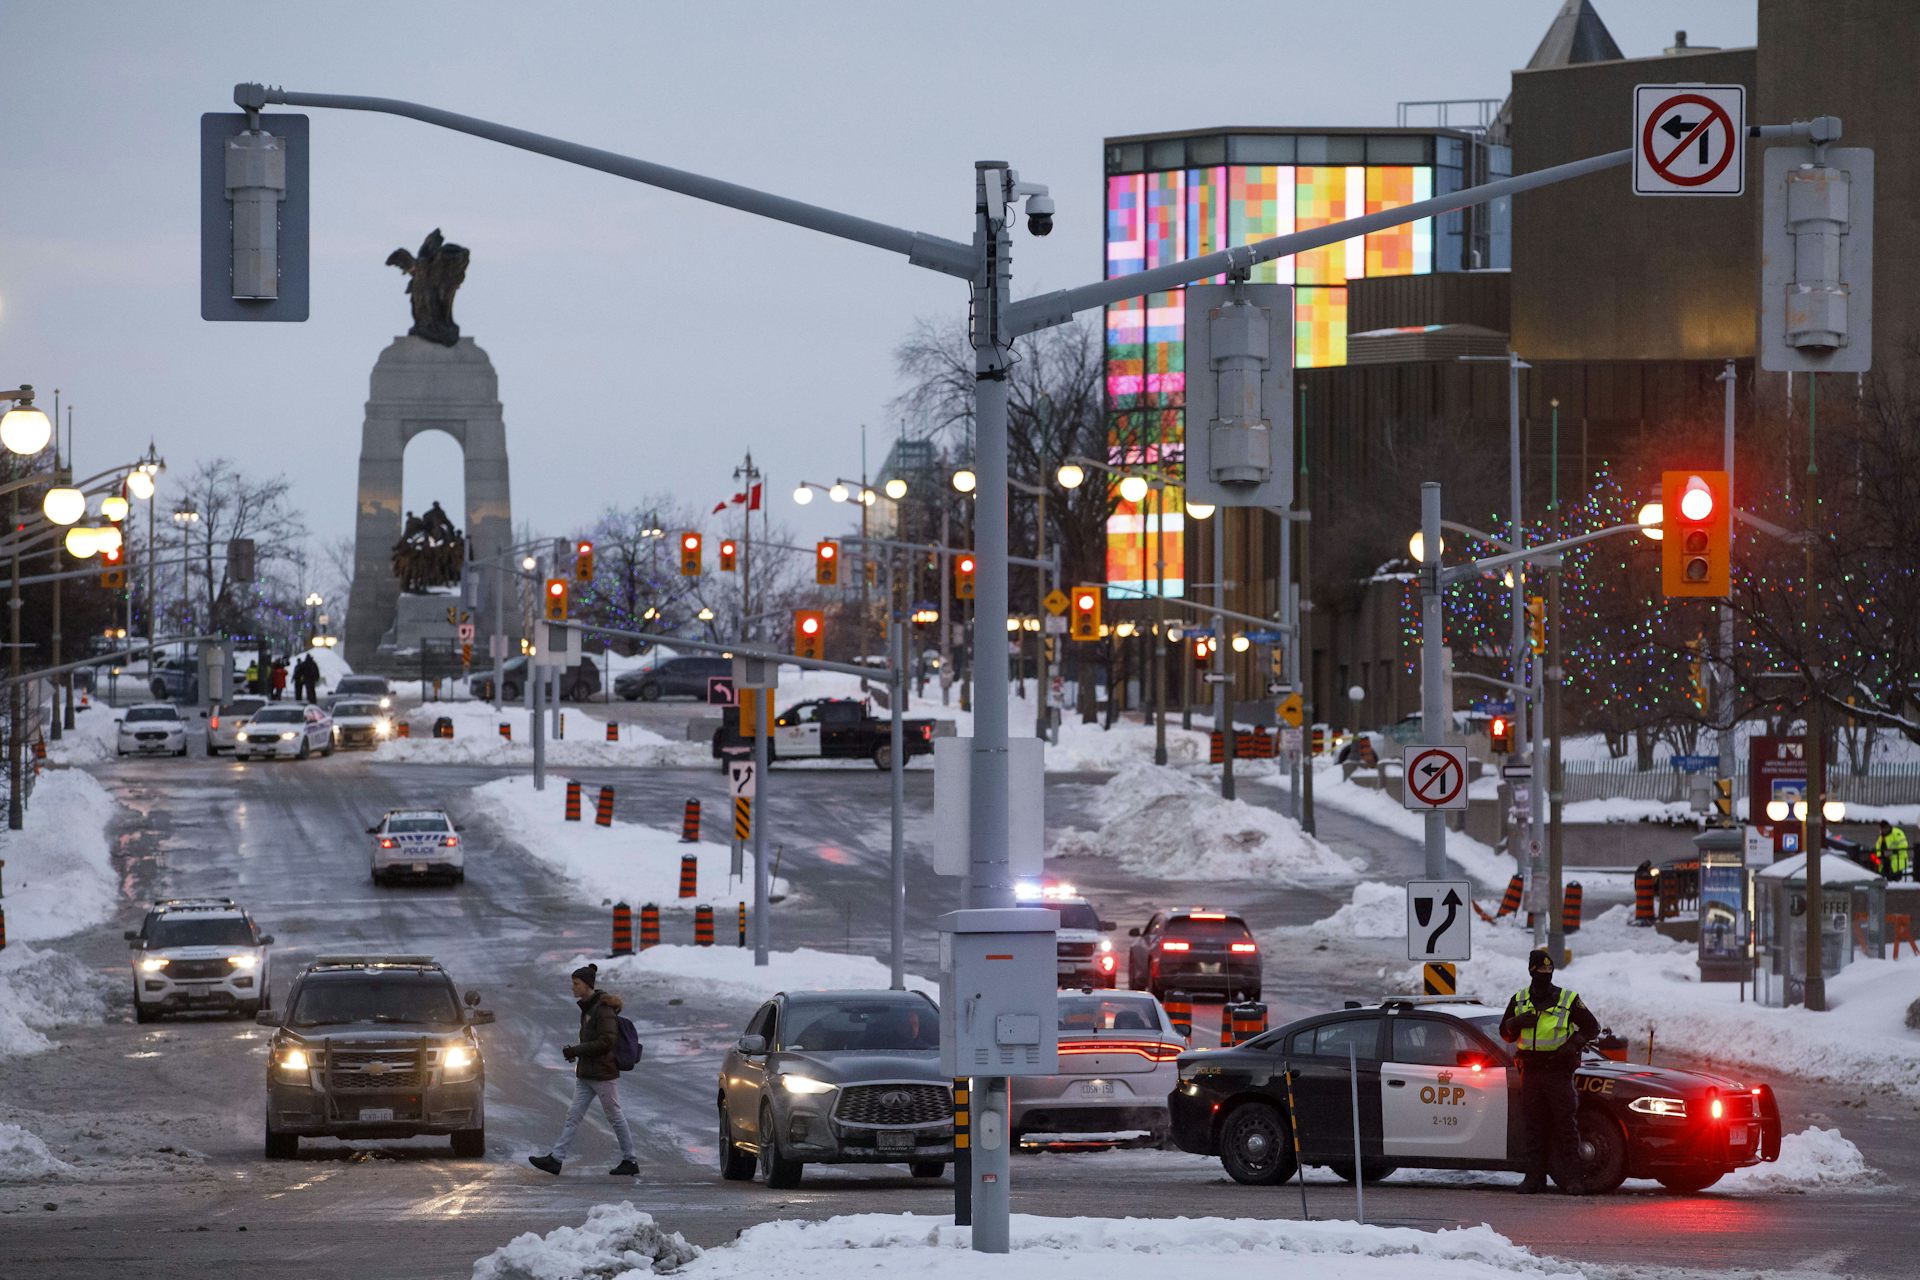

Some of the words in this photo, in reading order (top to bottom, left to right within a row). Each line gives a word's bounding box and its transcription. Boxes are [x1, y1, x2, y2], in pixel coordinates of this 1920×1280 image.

[403, 847, 434, 855] POLICE
[1820, 901, 1849, 914] FFEE
[1196, 1066, 1222, 1075] POLICE
[1575, 1076, 1615, 1095] LICE
[1420, 1086, 1466, 1106] O.P.P.
[1433, 1116, 1458, 1126] 2-129
